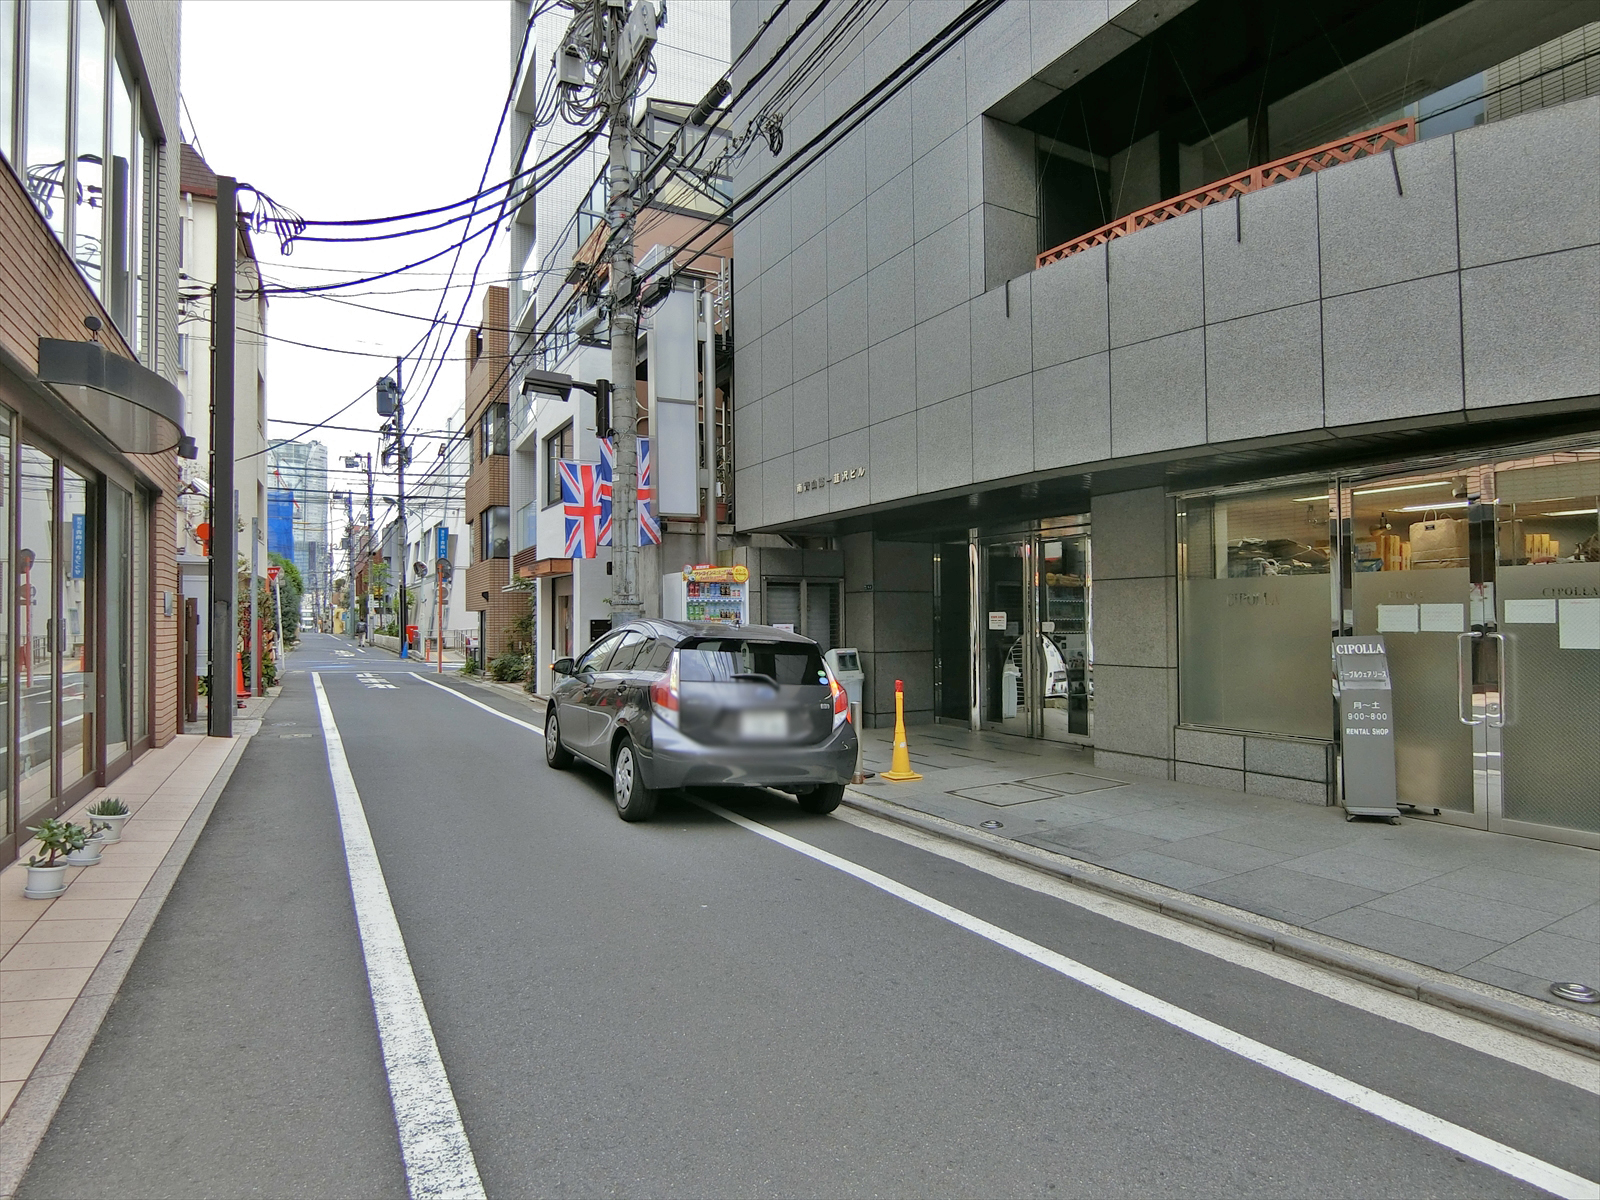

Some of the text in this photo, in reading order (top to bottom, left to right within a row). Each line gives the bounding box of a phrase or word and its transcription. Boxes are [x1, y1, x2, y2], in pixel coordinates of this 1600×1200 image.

[1541, 587, 1599, 597] CIPOLLA
[1336, 643, 1385, 655] CIPOLLA
[1346, 727, 1389, 736] RENTAL SHOP
